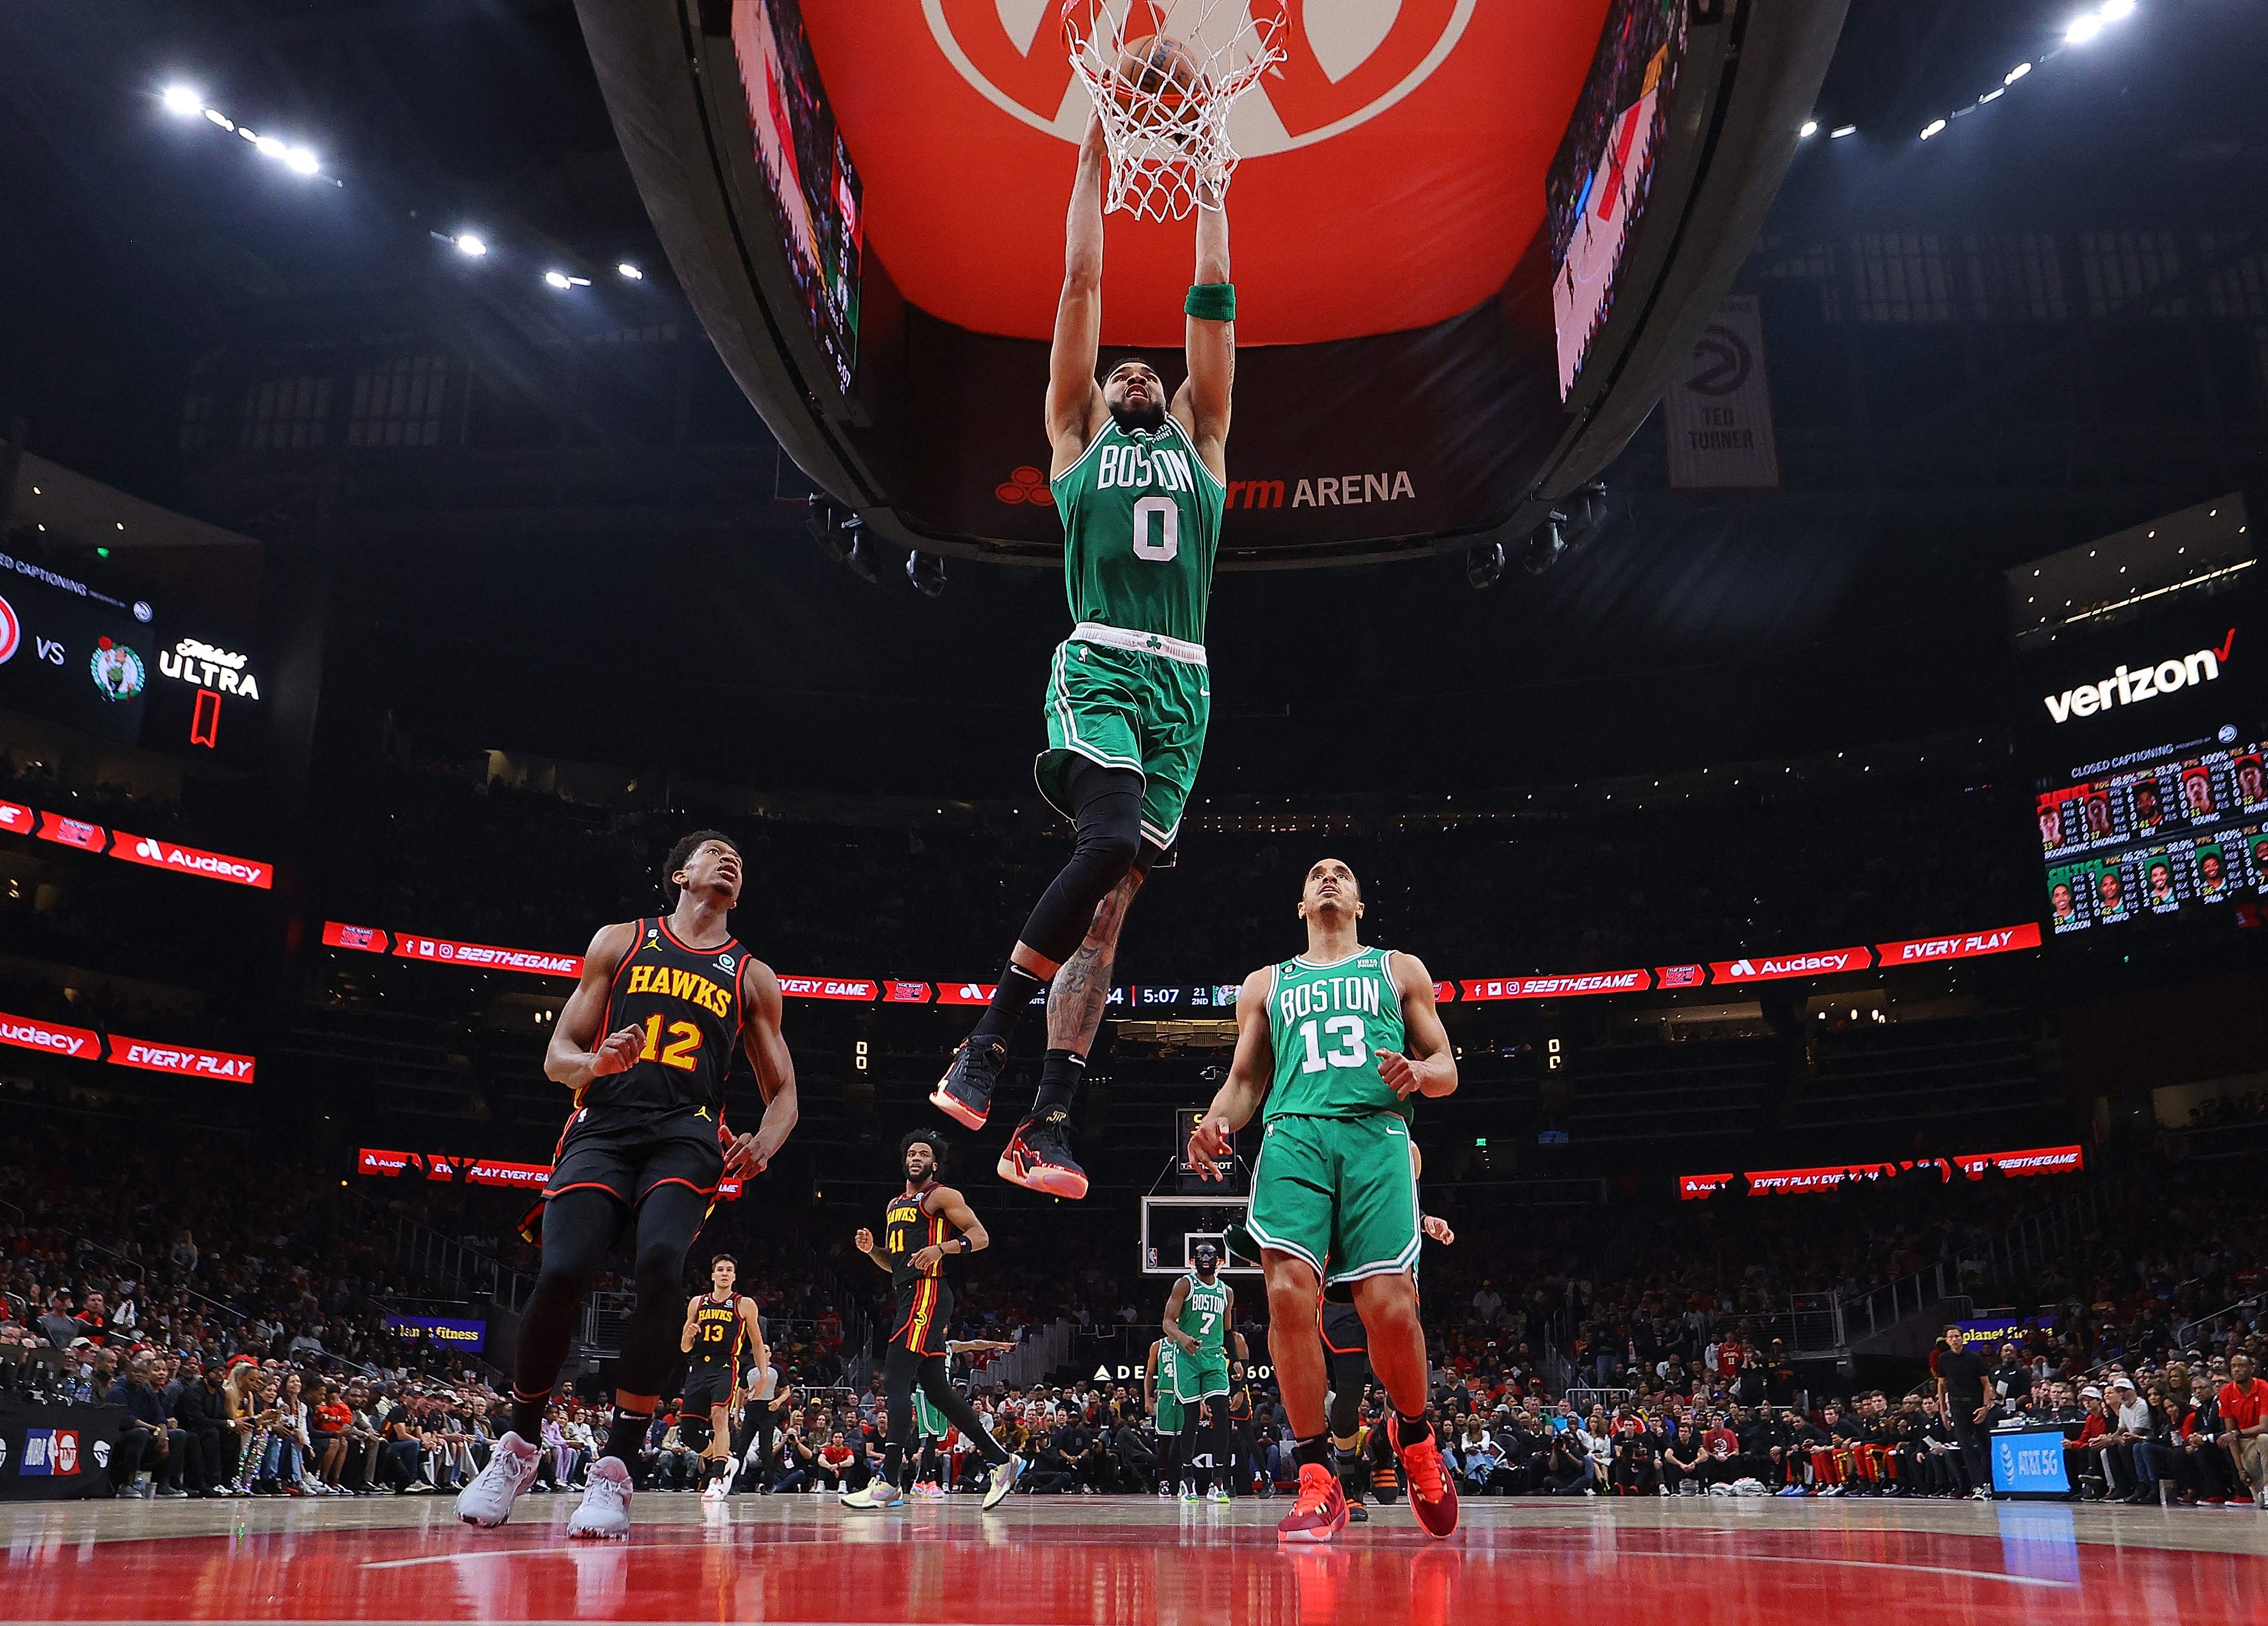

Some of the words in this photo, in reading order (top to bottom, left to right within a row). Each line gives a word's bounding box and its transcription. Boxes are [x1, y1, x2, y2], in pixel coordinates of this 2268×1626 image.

[1292, 470, 1416, 508] ARENA
[1133, 496, 1178, 562] 0
[36, 635, 66, 666] VS
[159, 650, 260, 700] ULTRA
[2044, 649, 2219, 723] verizon
[2248, 743, 2257, 754] 2
[2071, 760, 2110, 778] CLOSED
[2230, 769, 2237, 779] 1
[2175, 772, 2182, 782] 7
[2177, 782, 2184, 791] 3
[2231, 778, 2238, 788] 1
[2178, 791, 2186, 800] 0
[2233, 788, 2240, 797] 0
[2077, 797, 2084, 806] 7
[2127, 794, 2135, 803] 6
[2234, 797, 2242, 807] 0
[2079, 806, 2086, 814] 0
[2129, 803, 2135, 812] 1
[2180, 800, 2187, 810] 0
[2081, 814, 2087, 823] 1
[2130, 812, 2137, 821] 0
[2182, 809, 2189, 818] 0
[2082, 823, 2088, 832] 0
[2131, 821, 2138, 830] 2
[2083, 832, 2090, 841] 0
[2237, 838, 2249, 849] 11
[2184, 850, 2196, 860] 10
[2243, 848, 2251, 857] 3
[166, 849, 262, 883] Audacy
[2137, 861, 2144, 870] 2
[2245, 857, 2252, 867] 3
[2088, 872, 2095, 881] 9
[2138, 870, 2146, 880] 2
[2246, 867, 2254, 877] 0
[2090, 881, 2096, 890] 1
[2140, 879, 2147, 889] 0
[2193, 878, 2201, 887] 0
[2248, 876, 2256, 886] 0
[2092, 890, 2098, 899] 1
[2142, 888, 2148, 898] 1
[2195, 887, 2202, 897] 1
[2092, 899, 2099, 908] 0
[2143, 898, 2150, 907] 2
[2094, 908, 2101, 917] 0
[647, 929, 659, 939] 6
[1901, 938, 1962, 959] EVERY
[1964, 931, 2014, 952] PLAY
[454, 947, 577, 973] 929THEGAME
[1760, 952, 1849, 975] Audacy
[1284, 964, 1294, 973] 6
[1521, 973, 1638, 994] 929THEGAME
[626, 965, 733, 1019] HAWKS
[824, 982, 869, 996] GAME
[1193, 987, 1206, 996] 21
[1143, 988, 1180, 1003] 5:07
[1191, 997, 1209, 1006] 2ND
[1280, 976, 1380, 1029] BOSTON
[639, 1012, 703, 1072] 12
[1298, 1015, 1367, 1075] 13
[127, 1045, 197, 1071] EVERY
[195, 1055, 252, 1077] PLAY
[470, 1166, 500, 1178] PLAY
[500, 1169, 534, 1181] EVERY
[534, 1172, 549, 1182] GA
[1790, 1175, 1820, 1186] PLAY
[889, 1228, 905, 1254] 41
[1192, 1294, 1225, 1316] BOSTON
[698, 1309, 733, 1323] HAWKS
[1199, 1312, 1216, 1335] 7
[703, 1324, 724, 1342] 13
